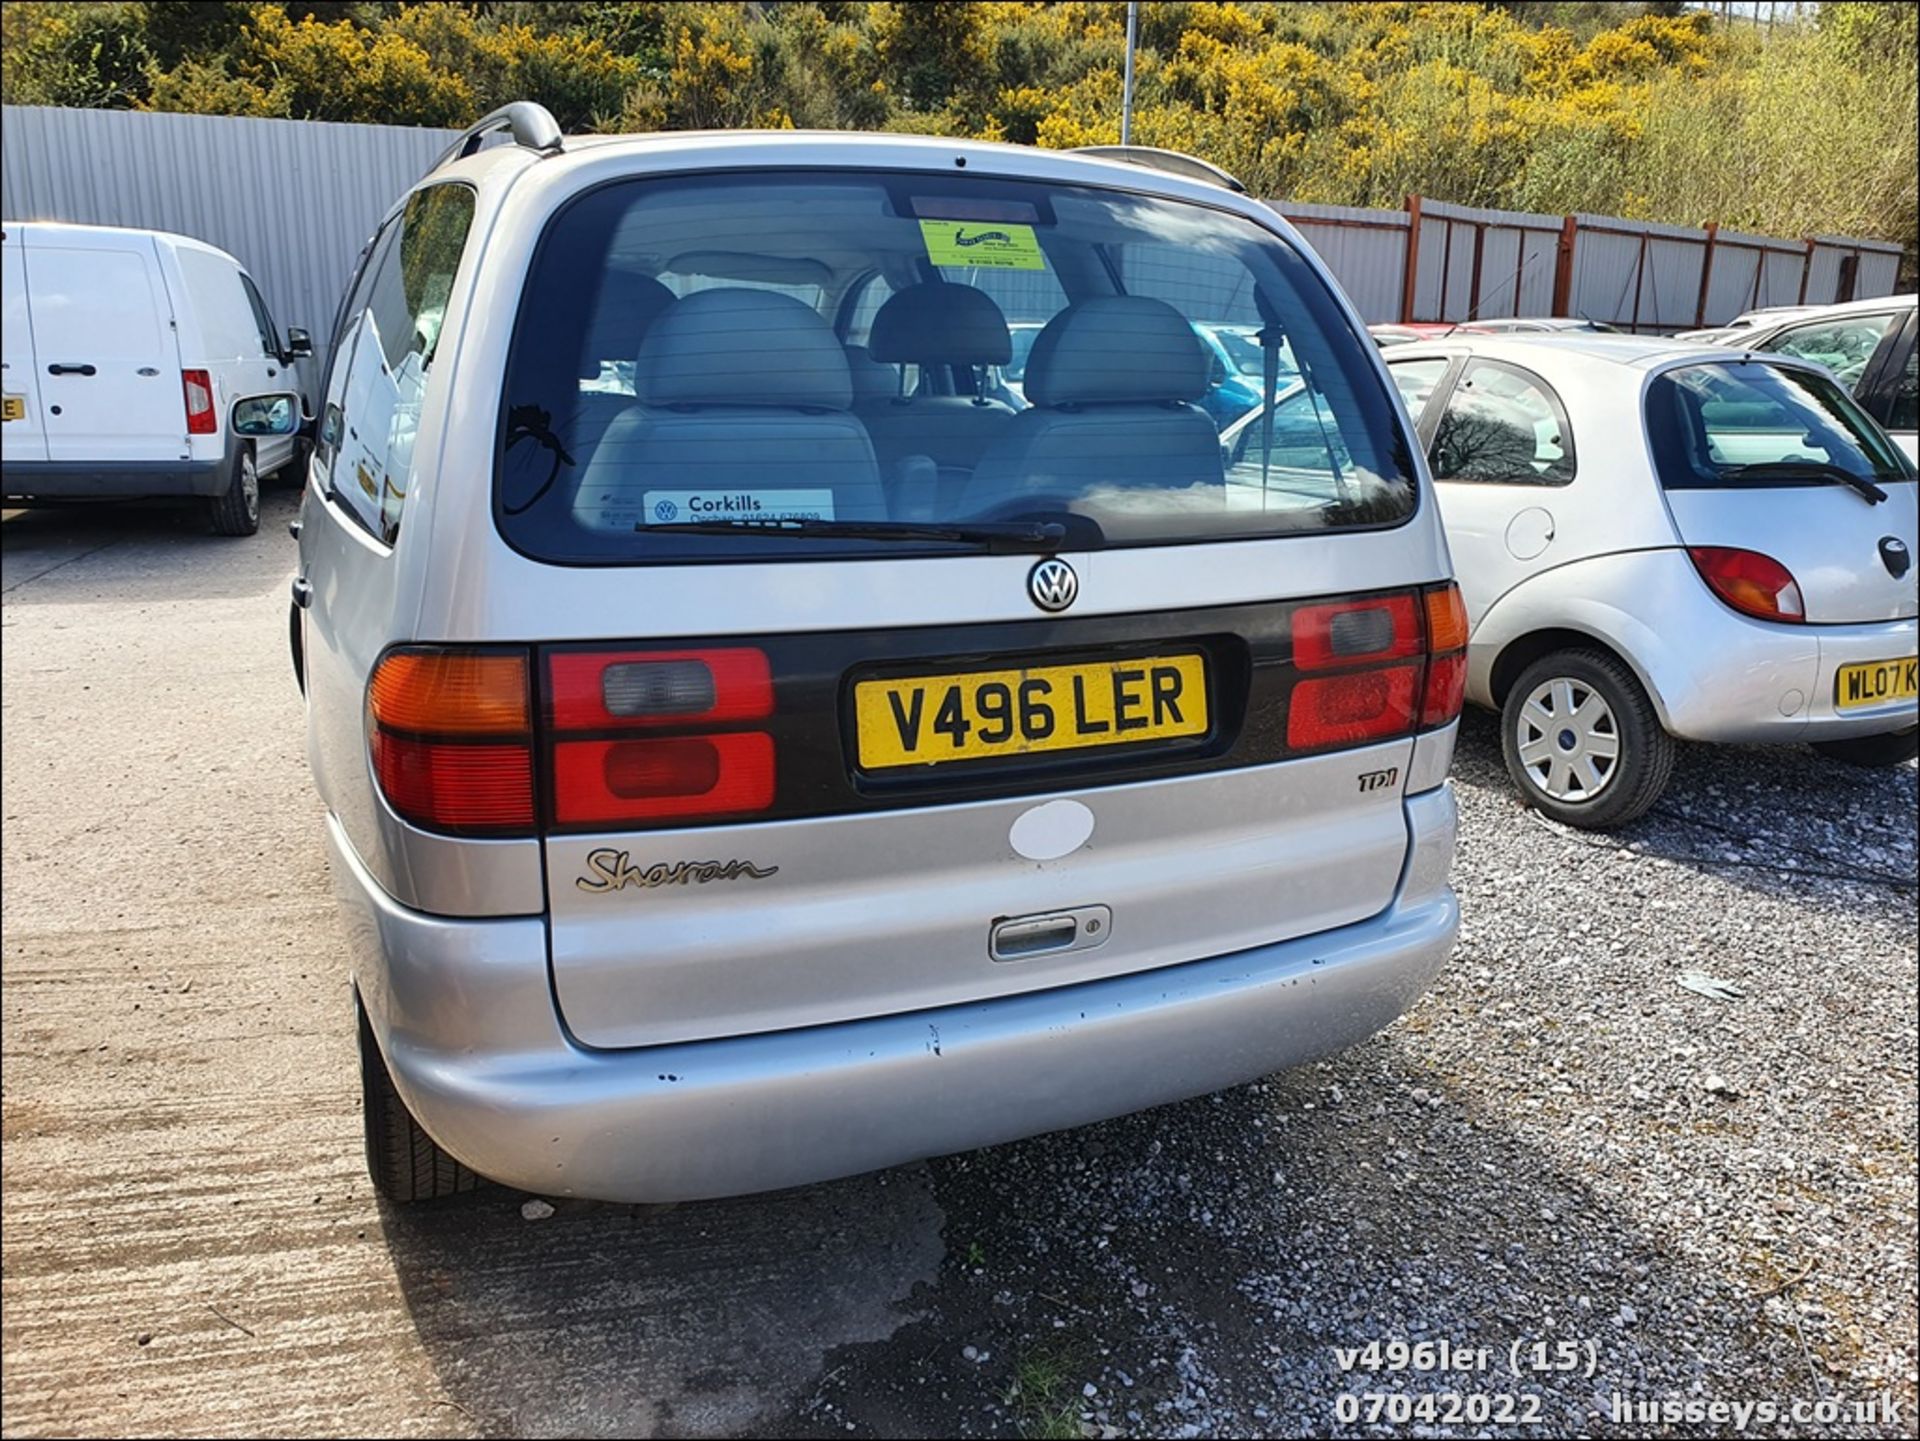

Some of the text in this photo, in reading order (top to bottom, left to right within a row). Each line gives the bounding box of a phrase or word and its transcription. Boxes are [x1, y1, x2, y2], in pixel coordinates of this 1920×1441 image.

[688, 494, 762, 512] Corkills
[1848, 664, 1900, 701] WL07
[887, 665, 1185, 752] V496 LER
[1358, 767, 1399, 793] TDI
[575, 848, 779, 893] Sharan
